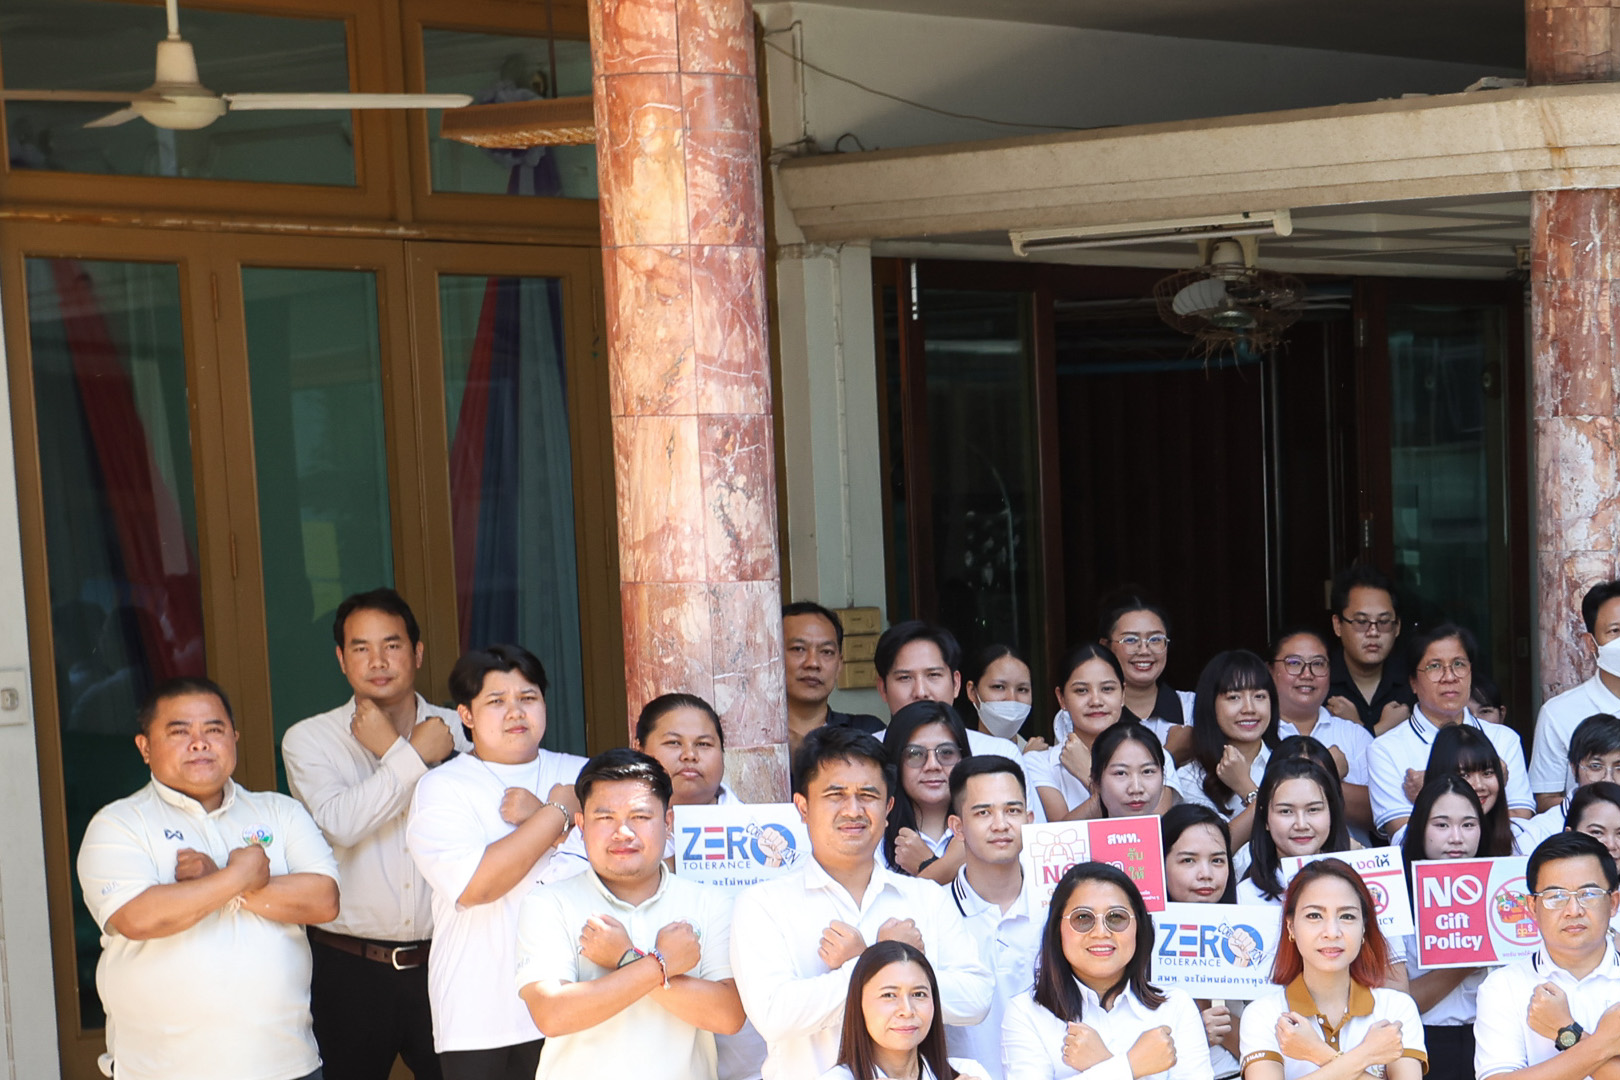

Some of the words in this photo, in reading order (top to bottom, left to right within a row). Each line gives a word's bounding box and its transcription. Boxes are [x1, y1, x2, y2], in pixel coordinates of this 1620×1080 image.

[682, 823, 797, 867] ZERO
[1107, 831, 1141, 845] สพท.
[683, 861, 751, 870] TOLERANCE
[1435, 912, 1470, 929] Gift
[1159, 924, 1264, 967] ZERO
[1424, 934, 1483, 951] Policy
[1158, 957, 1221, 968] TOLERANCE
